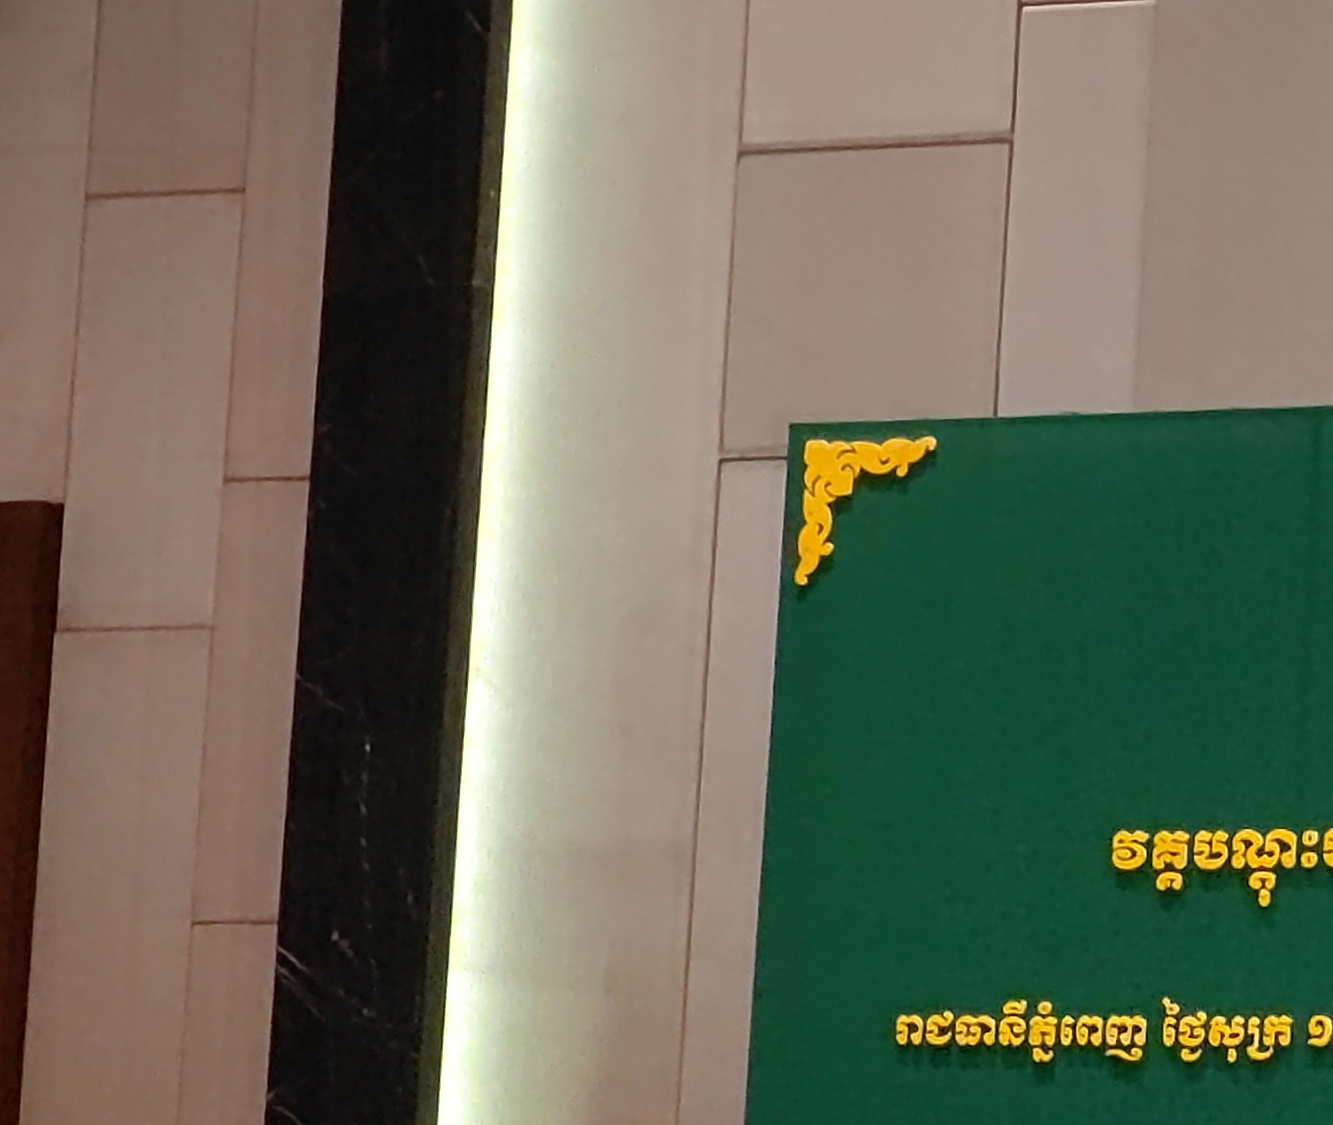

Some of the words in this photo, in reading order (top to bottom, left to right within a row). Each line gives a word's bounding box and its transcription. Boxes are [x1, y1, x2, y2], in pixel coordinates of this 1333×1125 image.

[896, 999, 1147, 1063] រាជធានីភ្នំពេញ
[1162, 997, 1293, 1062] ថ្ងៃសុក្រ
